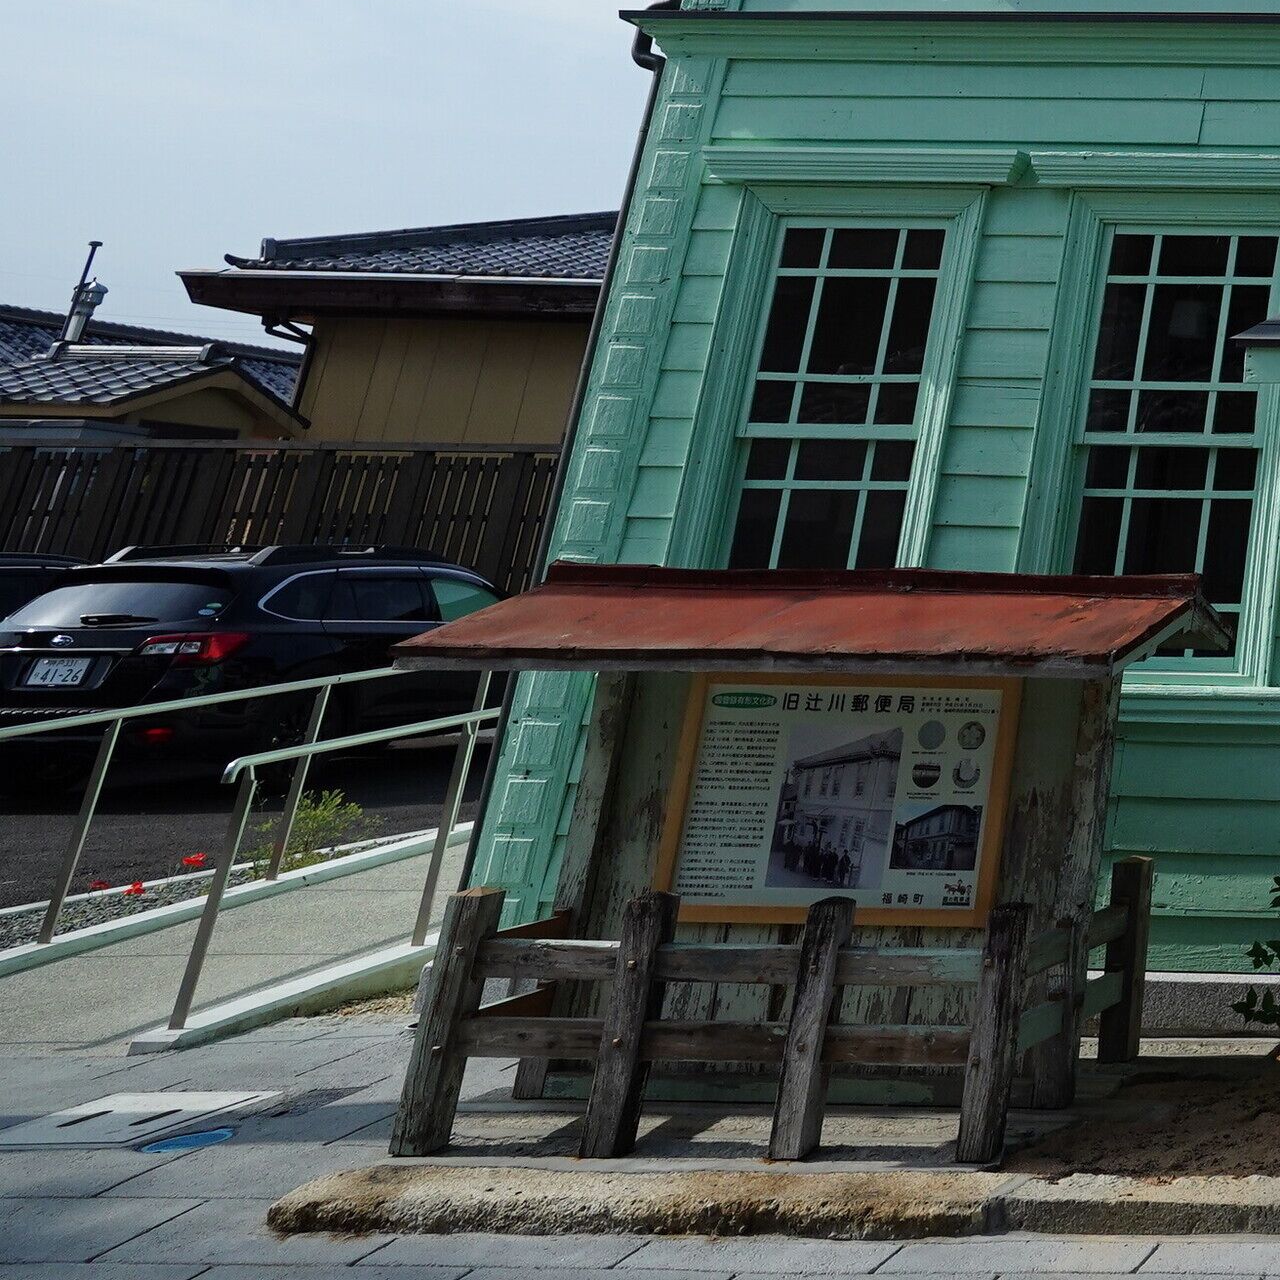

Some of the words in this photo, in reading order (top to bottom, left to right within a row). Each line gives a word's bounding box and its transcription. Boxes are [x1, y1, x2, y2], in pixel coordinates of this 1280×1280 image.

[40, 669, 82, 682] 41-26
[782, 693, 915, 713] 旧辻川郵便局
[882, 893, 924, 904] 福崎町
